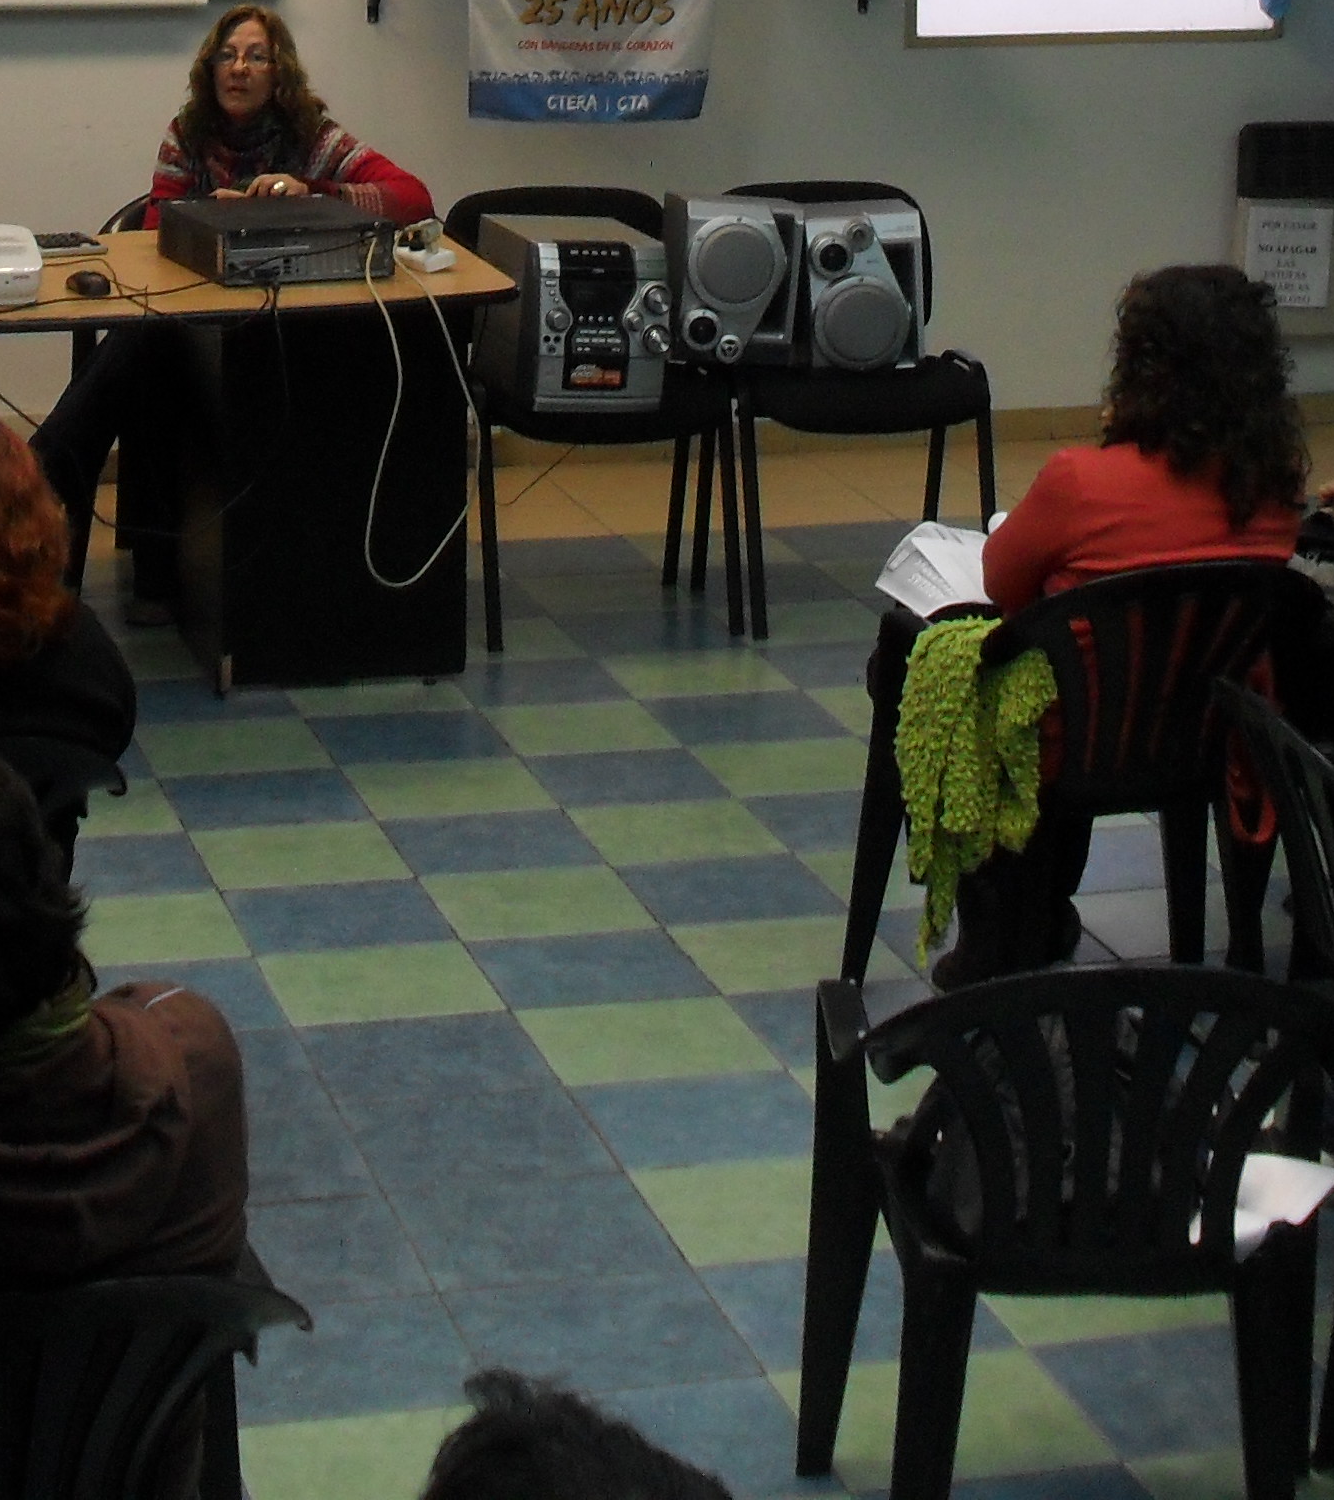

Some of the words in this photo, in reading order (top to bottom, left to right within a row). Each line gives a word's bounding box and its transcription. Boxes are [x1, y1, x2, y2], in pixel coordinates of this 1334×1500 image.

[517, 39, 538, 50] CON
[546, 95, 597, 111] CTERA
[617, 95, 649, 111] CTA
